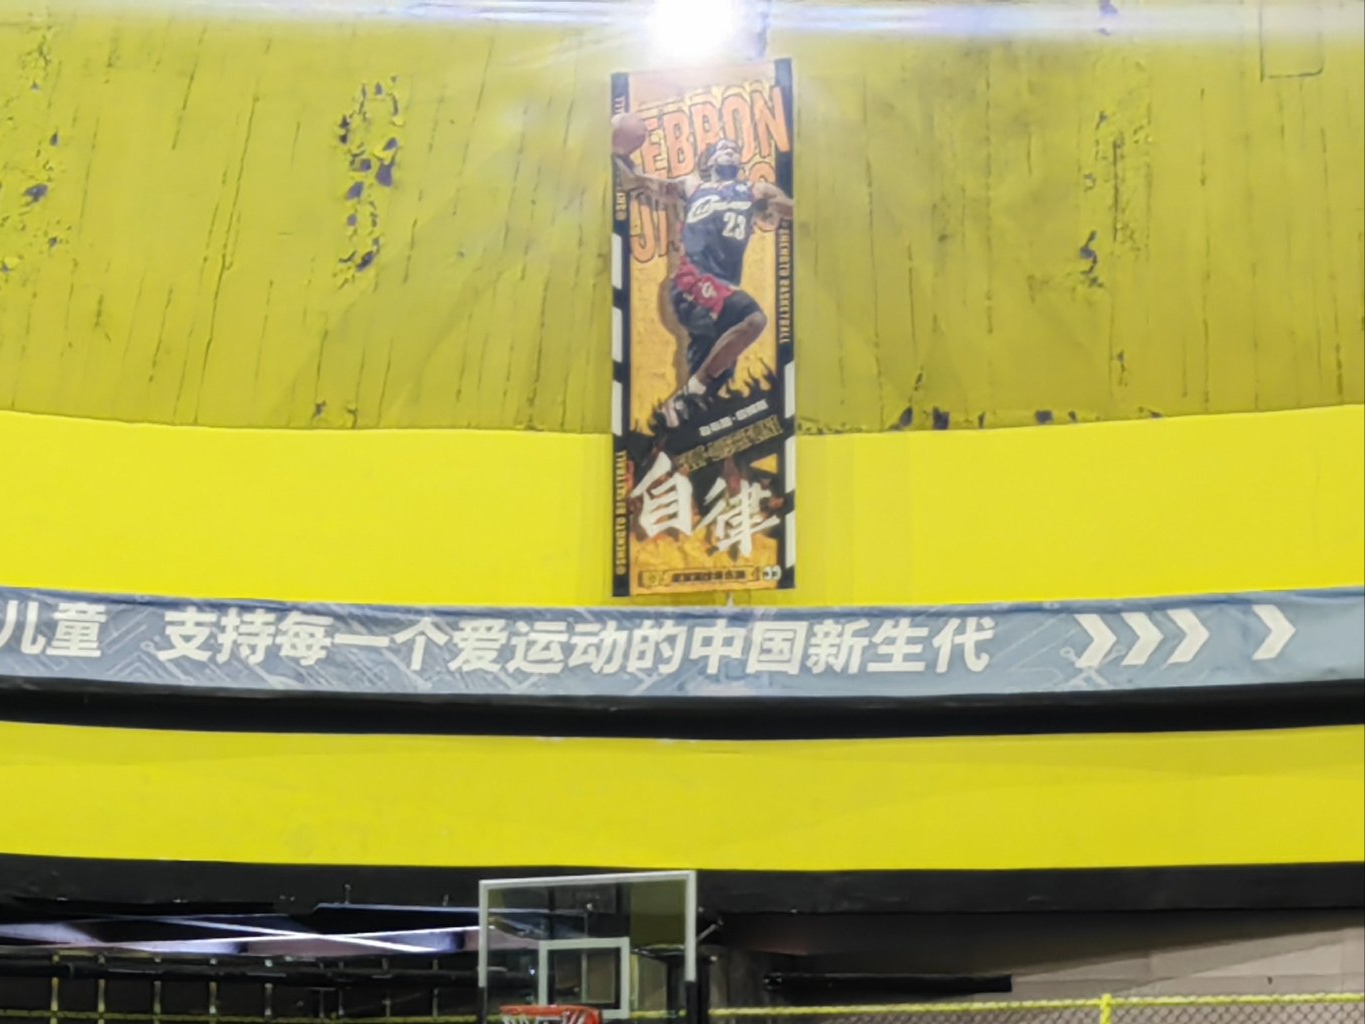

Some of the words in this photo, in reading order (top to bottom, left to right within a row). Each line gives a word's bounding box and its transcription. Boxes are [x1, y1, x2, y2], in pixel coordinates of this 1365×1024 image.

[722, 211, 747, 240] 23
[630, 452, 781, 558] 自律
[157, 607, 995, 675] 支持每一个爱运动的中国新生代
